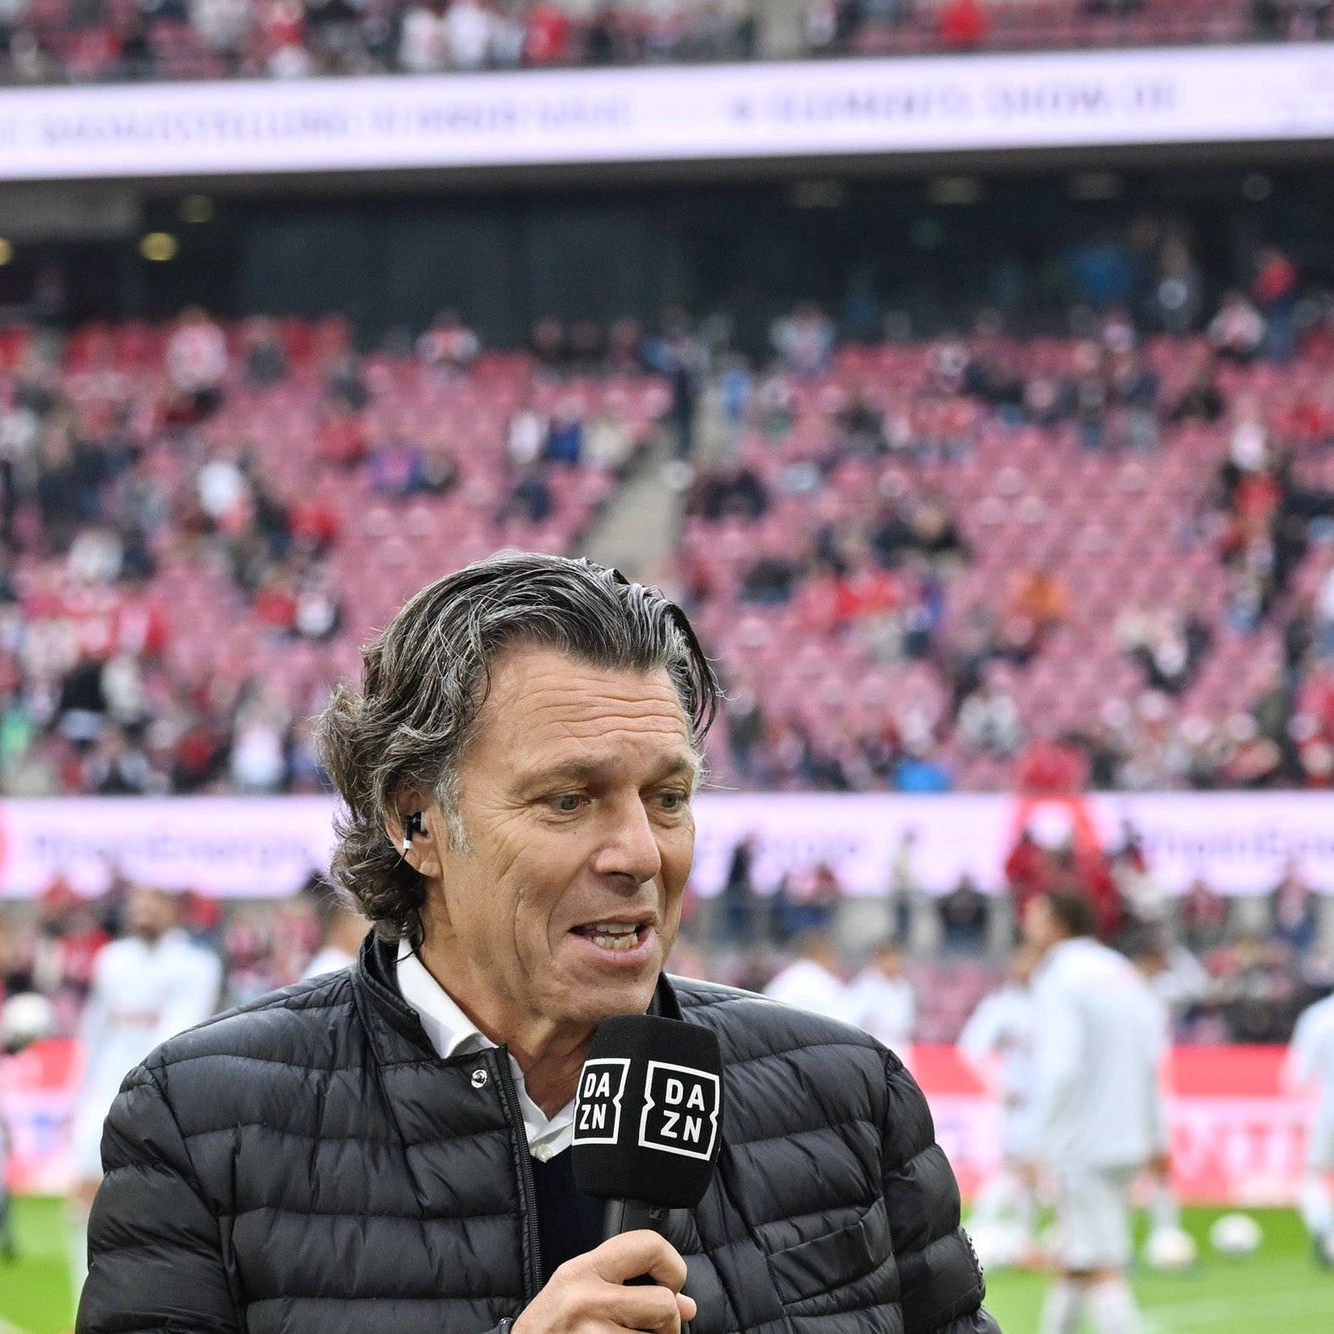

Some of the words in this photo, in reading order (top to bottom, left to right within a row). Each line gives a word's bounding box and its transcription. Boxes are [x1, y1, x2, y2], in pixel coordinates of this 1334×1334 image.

[583, 1072, 610, 1098] DA
[665, 1078, 705, 1112] DA
[579, 1103, 607, 1130] ZN
[660, 1109, 703, 1143] ZN
